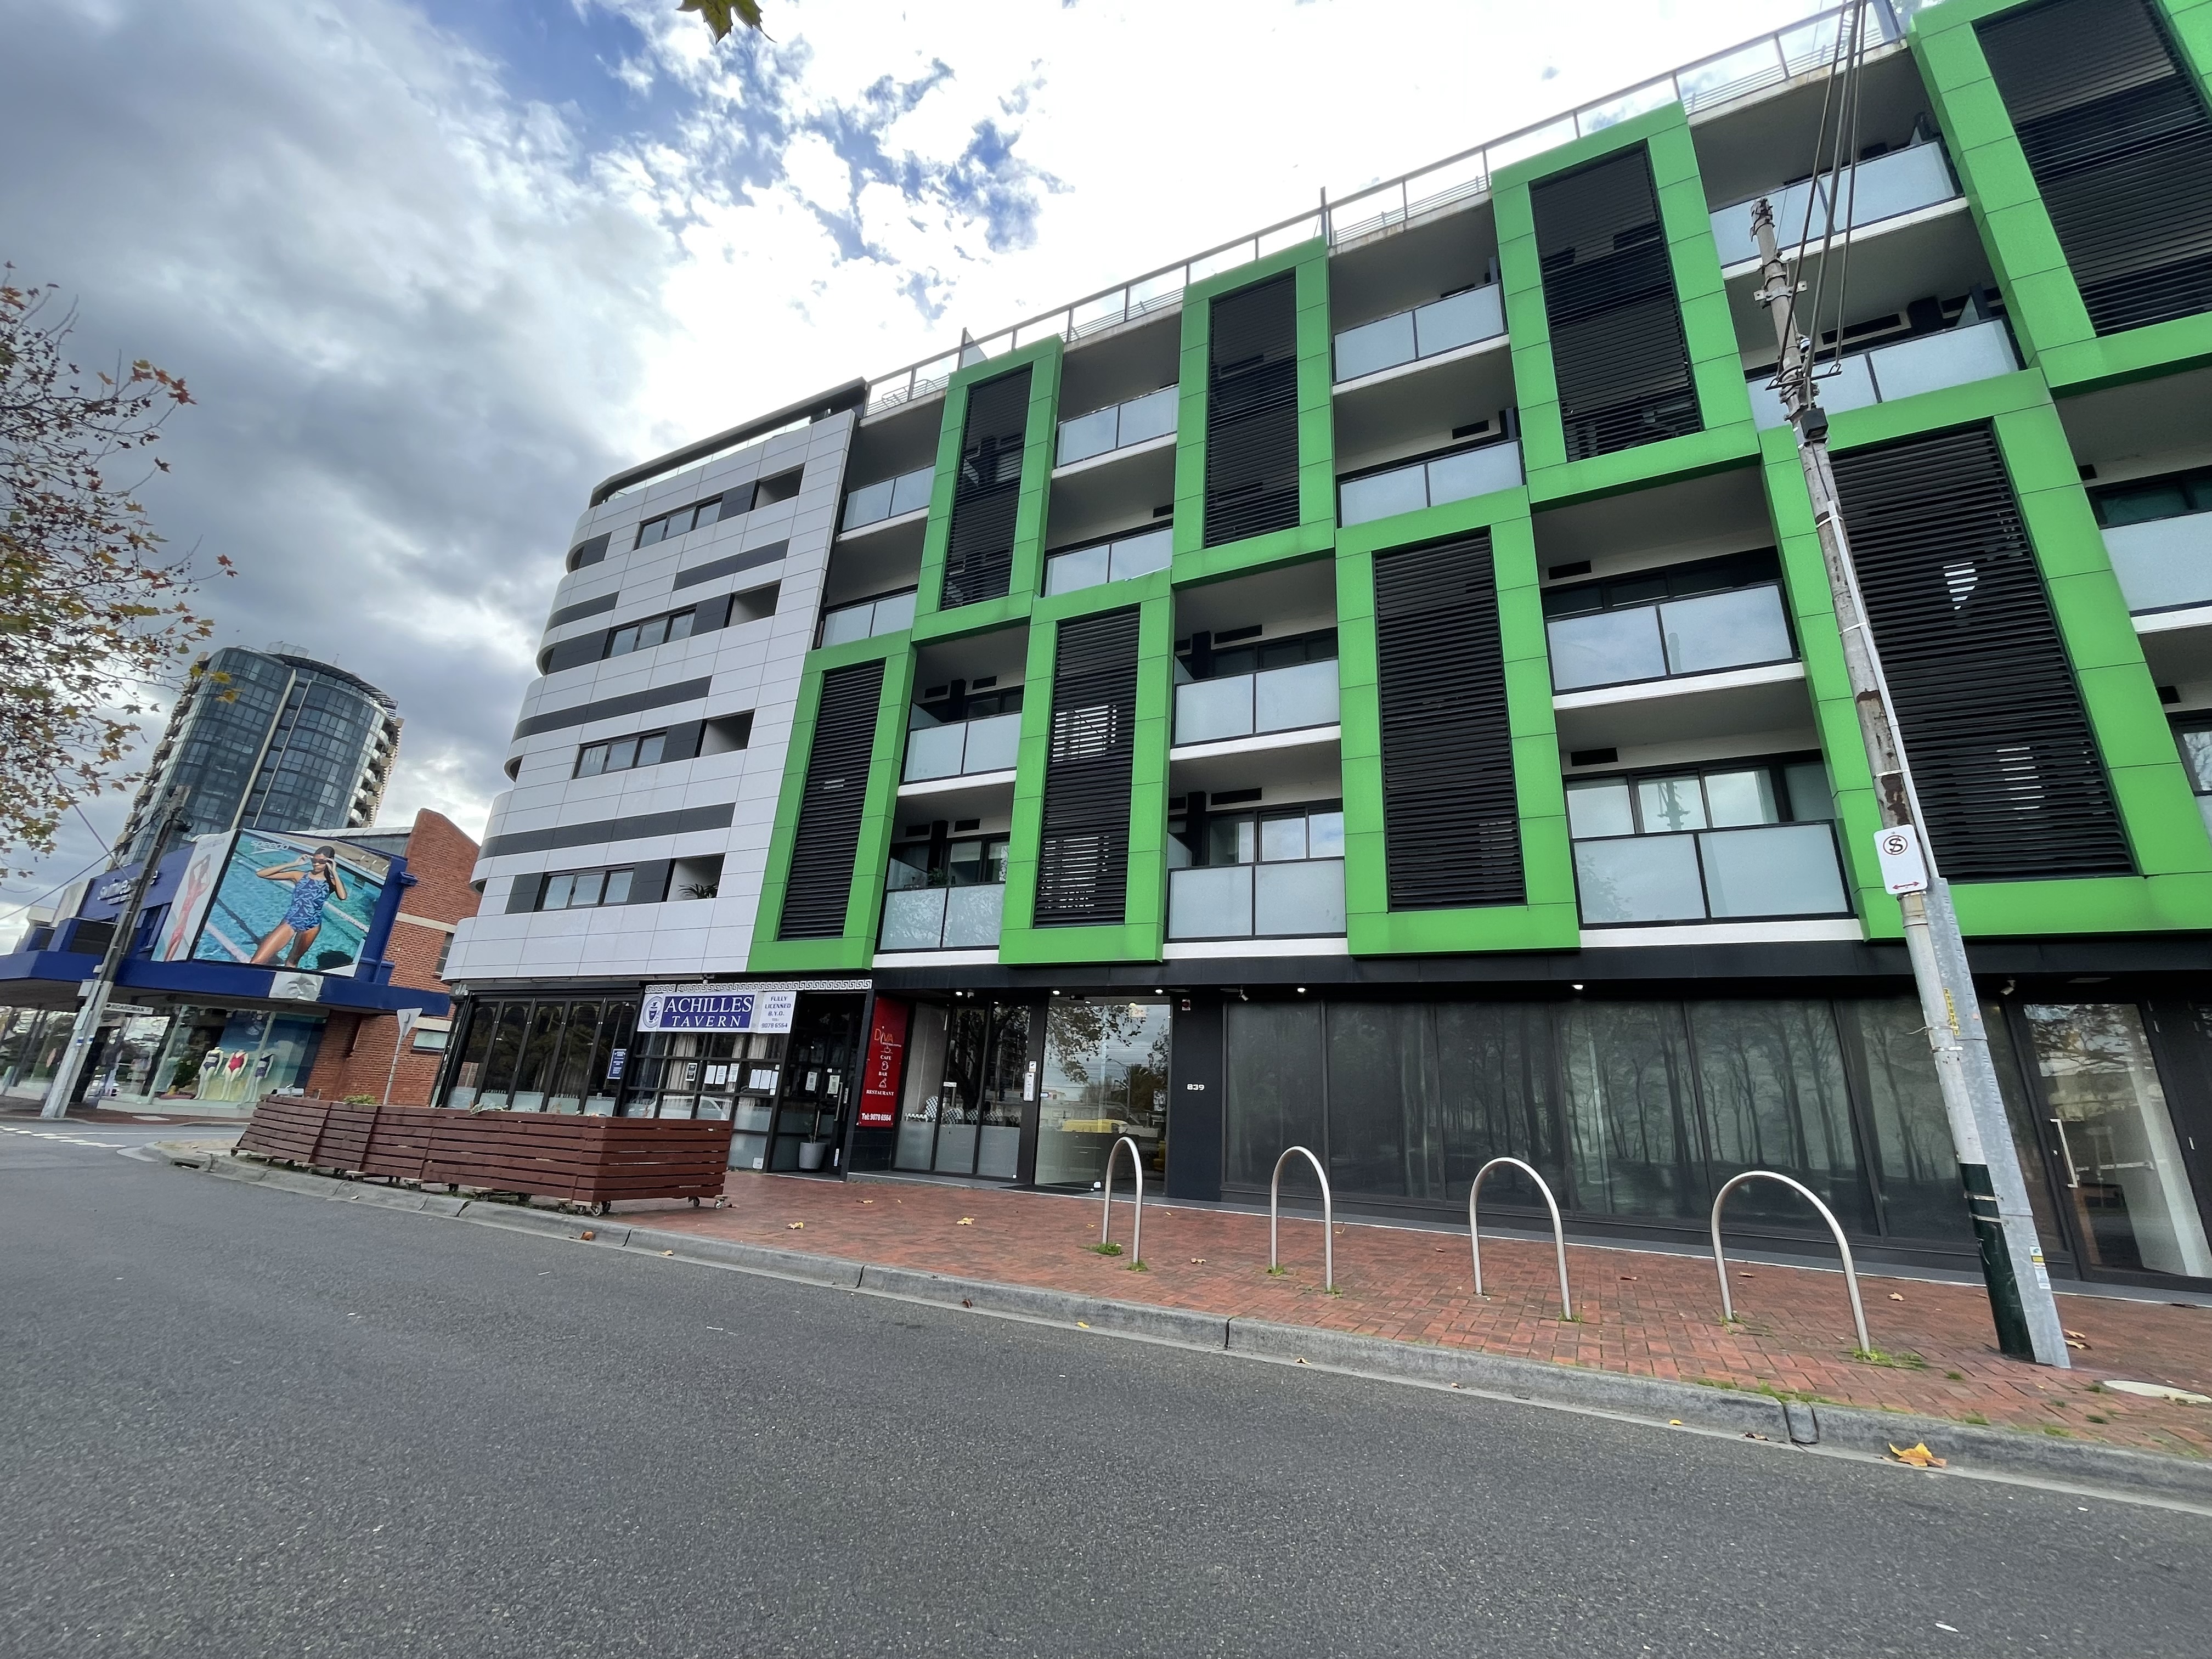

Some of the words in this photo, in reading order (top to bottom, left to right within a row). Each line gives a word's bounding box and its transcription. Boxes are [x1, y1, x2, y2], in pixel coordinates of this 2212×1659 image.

[250, 840, 290, 850] speedo
[664, 996, 753, 1013] ACHILLES
[672, 1015, 742, 1028] TAVERN
